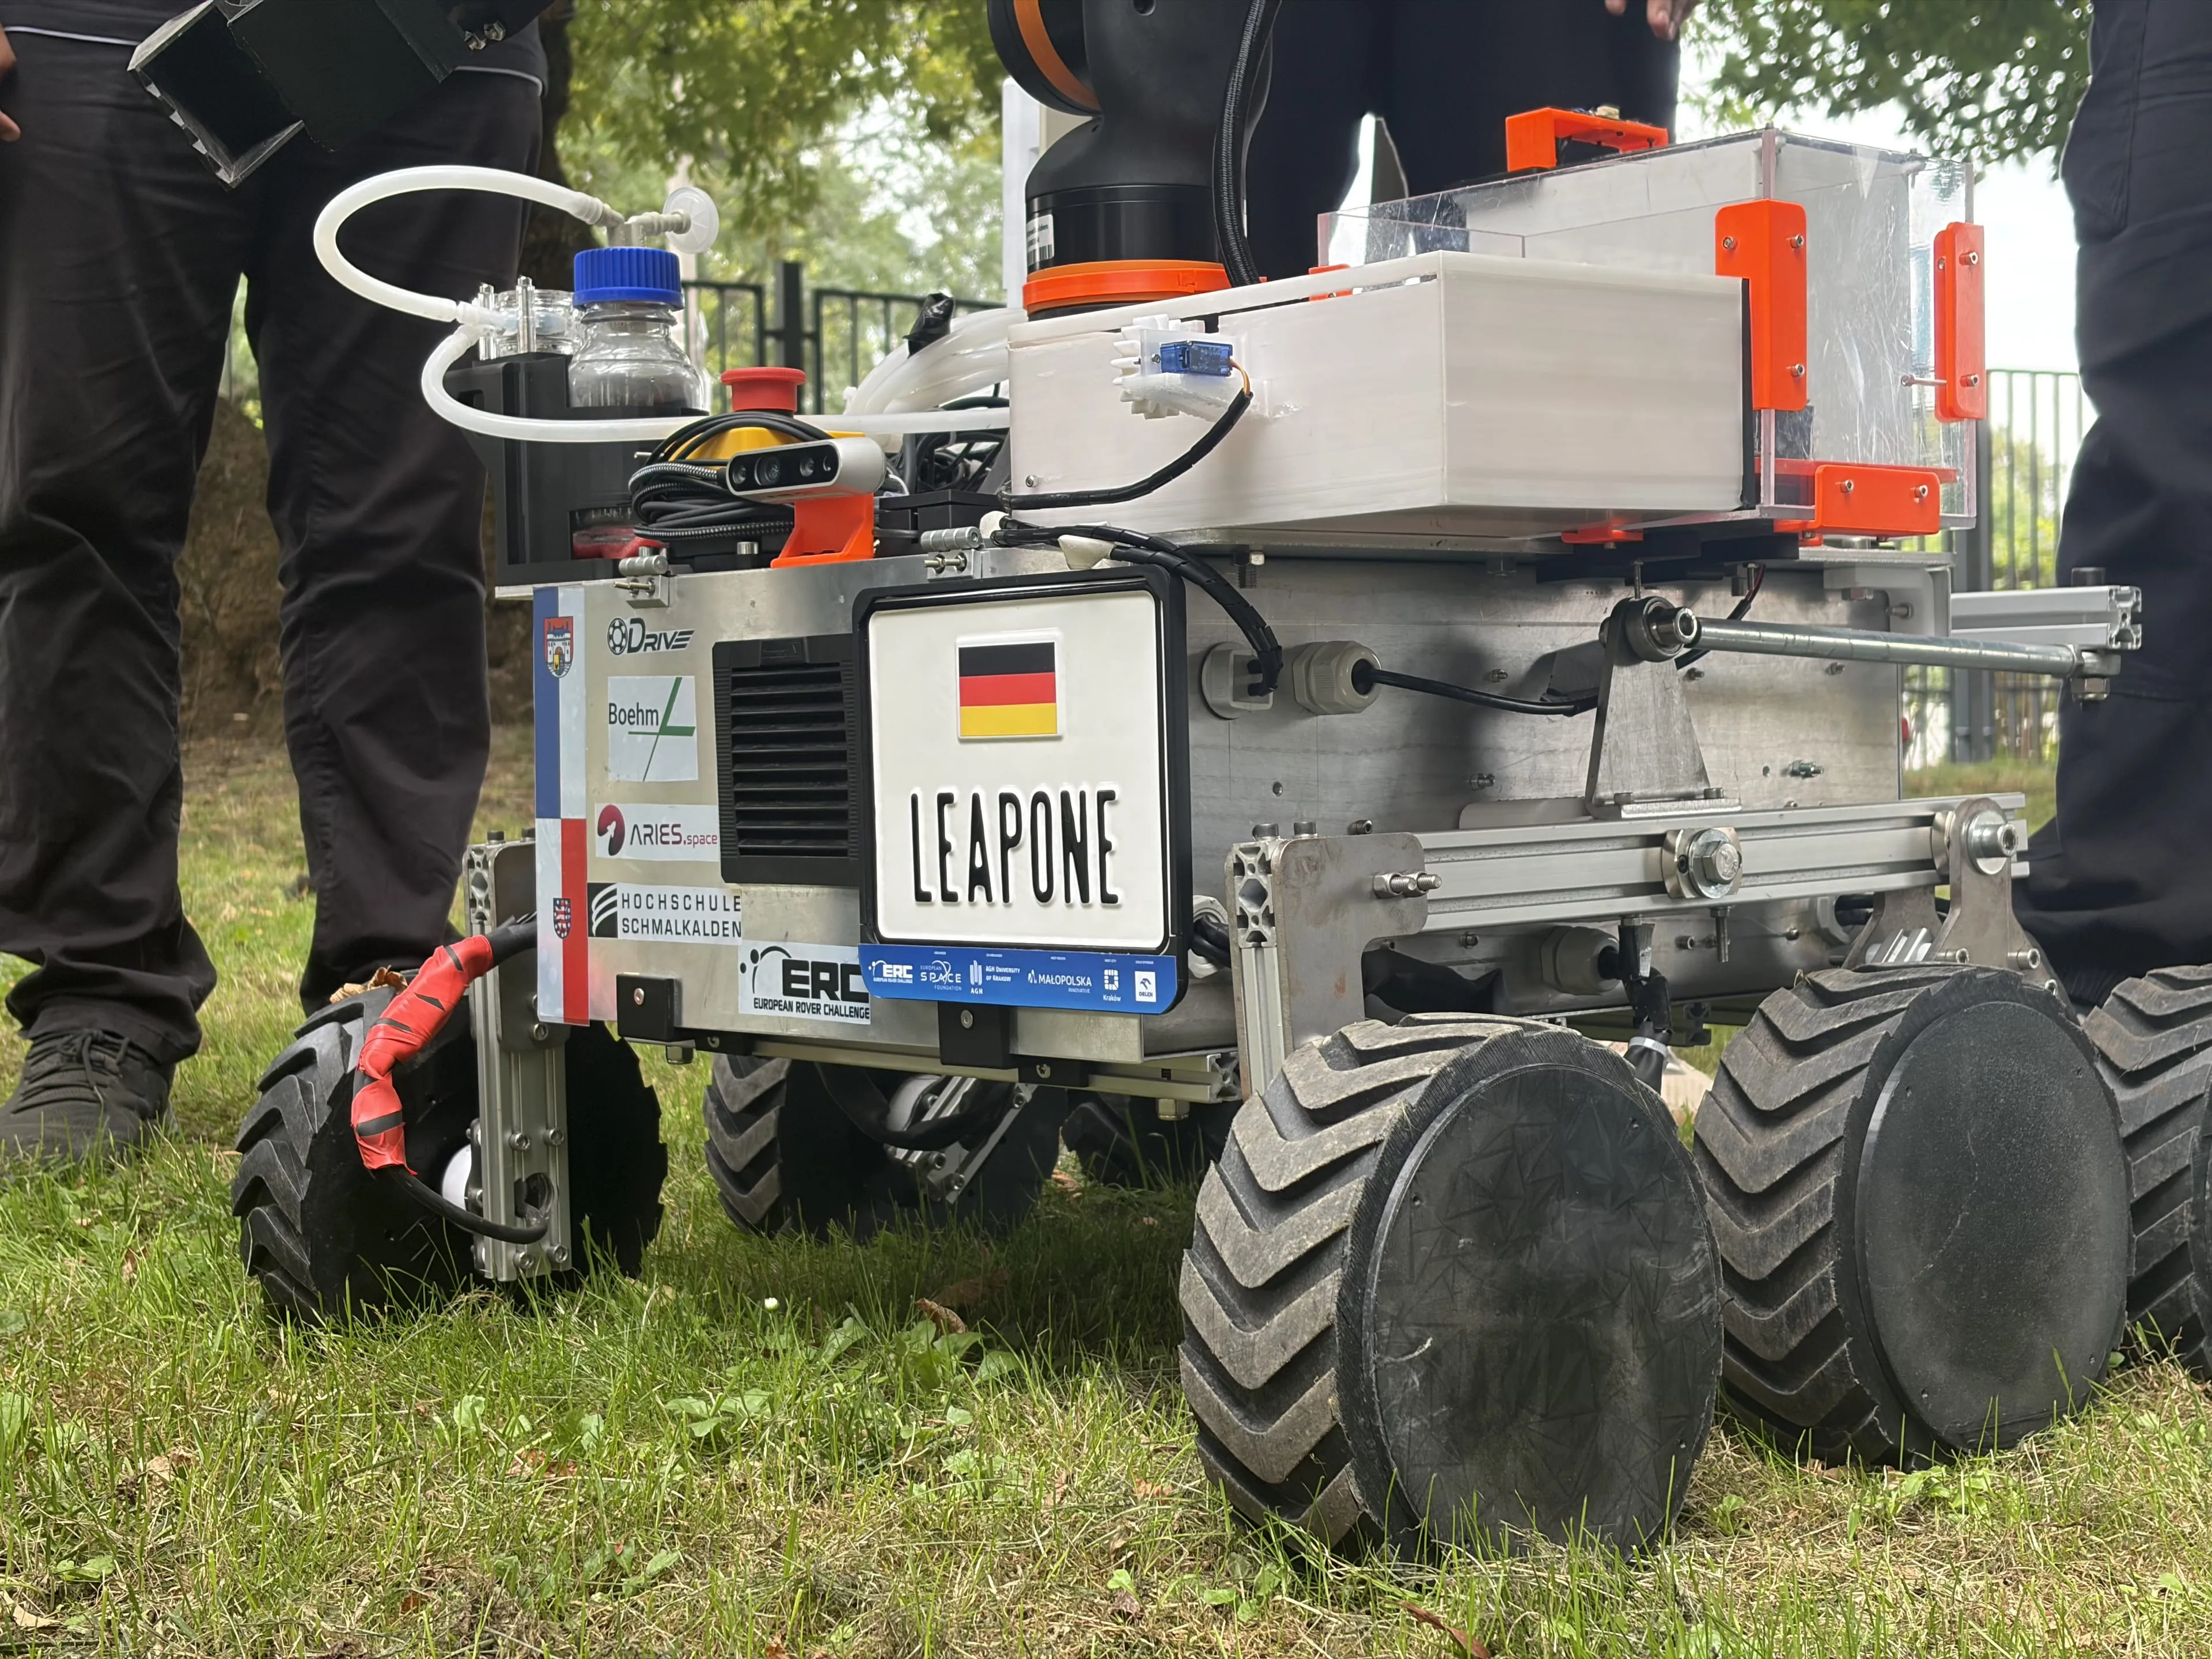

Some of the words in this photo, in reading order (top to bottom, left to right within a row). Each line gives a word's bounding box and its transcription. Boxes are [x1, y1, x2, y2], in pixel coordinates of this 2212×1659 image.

[609, 702, 658, 726] Boehm
[630, 824, 718, 848] ARIES.space
[911, 790, 1119, 904] LEAPONE
[622, 893, 741, 912] HOCHSCHULE
[622, 918, 742, 938] SCHMALKALDEN
[782, 959, 869, 1003] ERC
[882, 964, 913, 978] ERC
[921, 972, 961, 983] SPACE
[1038, 974, 1092, 987] MAŁOPOLSKA
[753, 997, 793, 1012] EUROPEAN
[796, 1001, 821, 1016] ROVER
[823, 1003, 870, 1020] CHALLENGE
